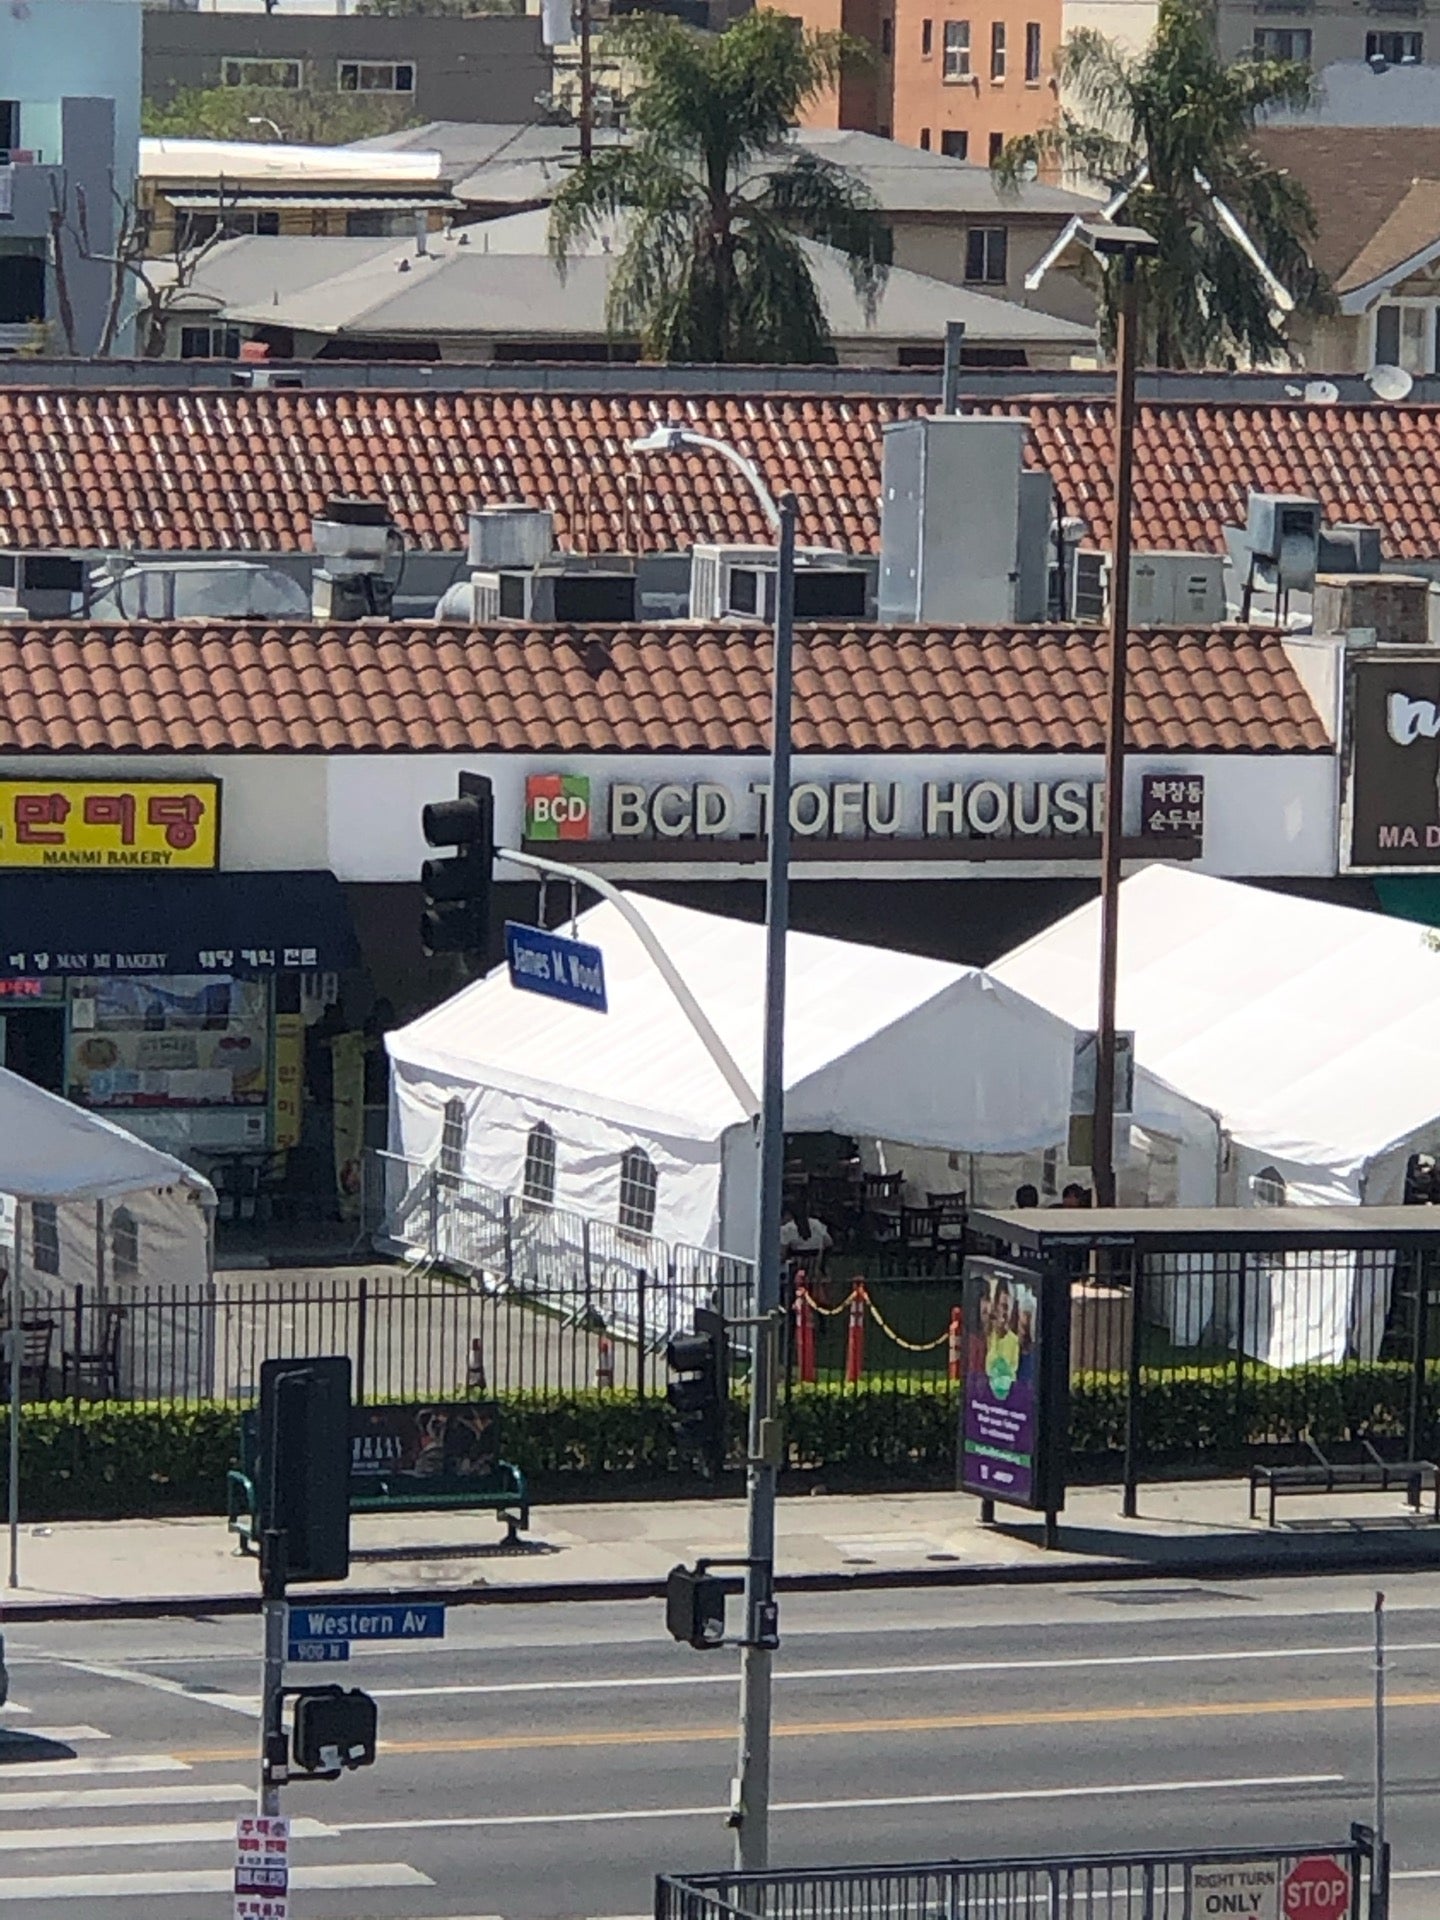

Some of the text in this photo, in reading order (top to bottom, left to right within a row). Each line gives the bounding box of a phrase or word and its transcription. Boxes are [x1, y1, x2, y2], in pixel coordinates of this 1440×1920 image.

[1150, 781, 1204, 803] 북창동
[533, 797, 586, 823] BCD
[609, 782, 735, 836] BCD
[1149, 809, 1204, 831] 순두부
[15, 793, 205, 849] 만미당
[1378, 825, 1418, 847] MA
[43, 851, 173, 865] MANMI BAKERY
[116, 953, 168, 969] BAKERY
[308, 1610, 427, 1635] Western Av
[1194, 1871, 1275, 1888] RIGHT TURN
[1206, 1893, 1261, 1913] ONLY
[1287, 1880, 1345, 1908] STOP
